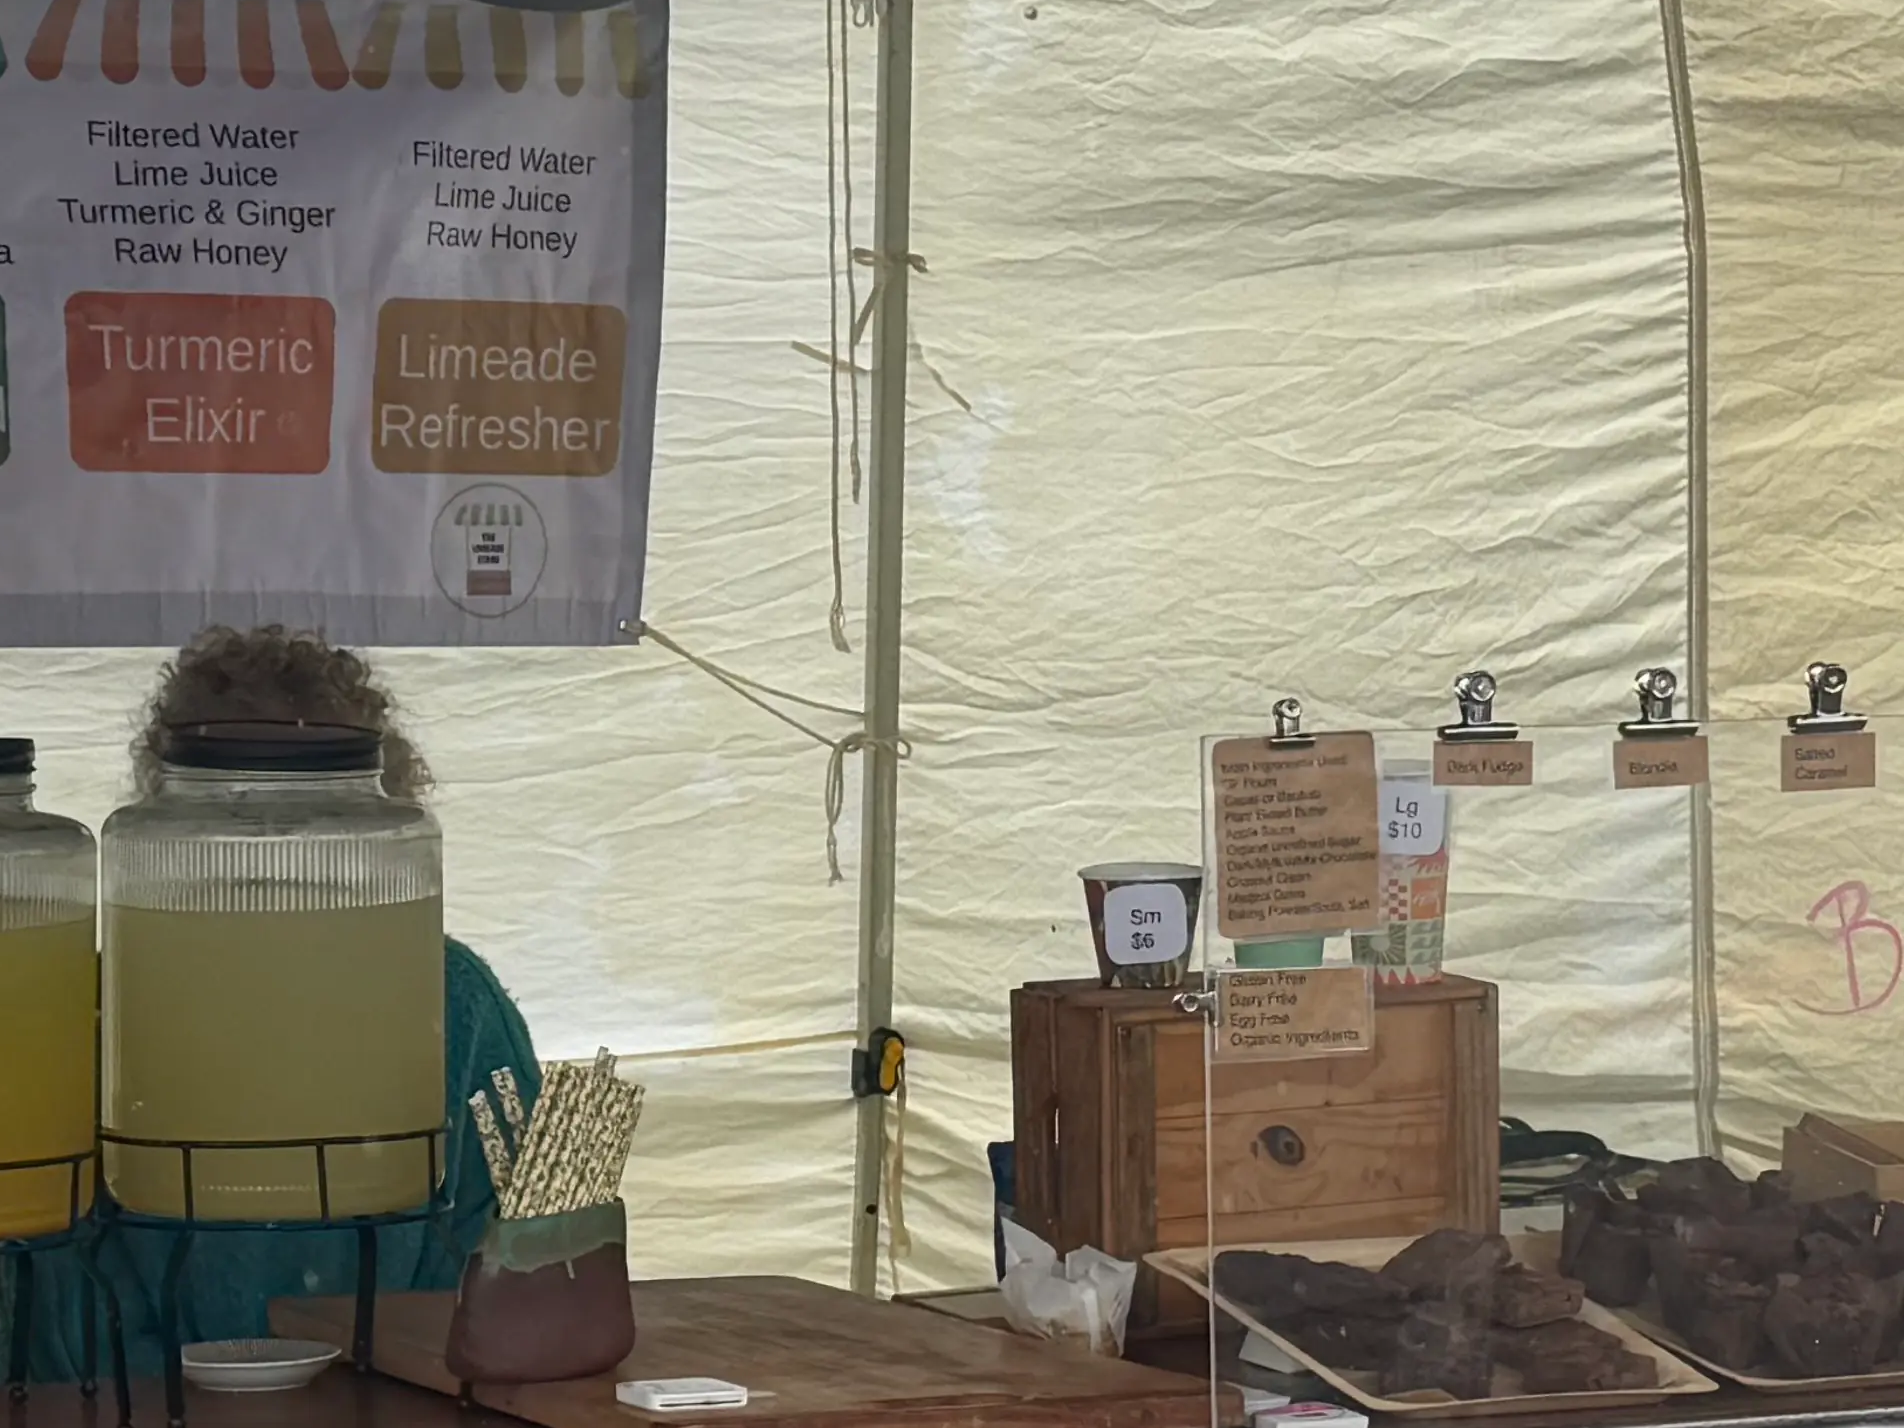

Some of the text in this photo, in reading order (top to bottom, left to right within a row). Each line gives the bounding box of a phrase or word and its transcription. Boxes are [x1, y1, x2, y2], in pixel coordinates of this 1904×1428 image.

[89, 325, 313, 374] Turmeric
[400, 330, 595, 381] Limeade
[147, 396, 265, 443] Elixir
[381, 404, 610, 451] Refresher
[1388, 821, 1421, 838] $10
[1396, 797, 1418, 818] Lg
[1131, 909, 1160, 925] Sm
